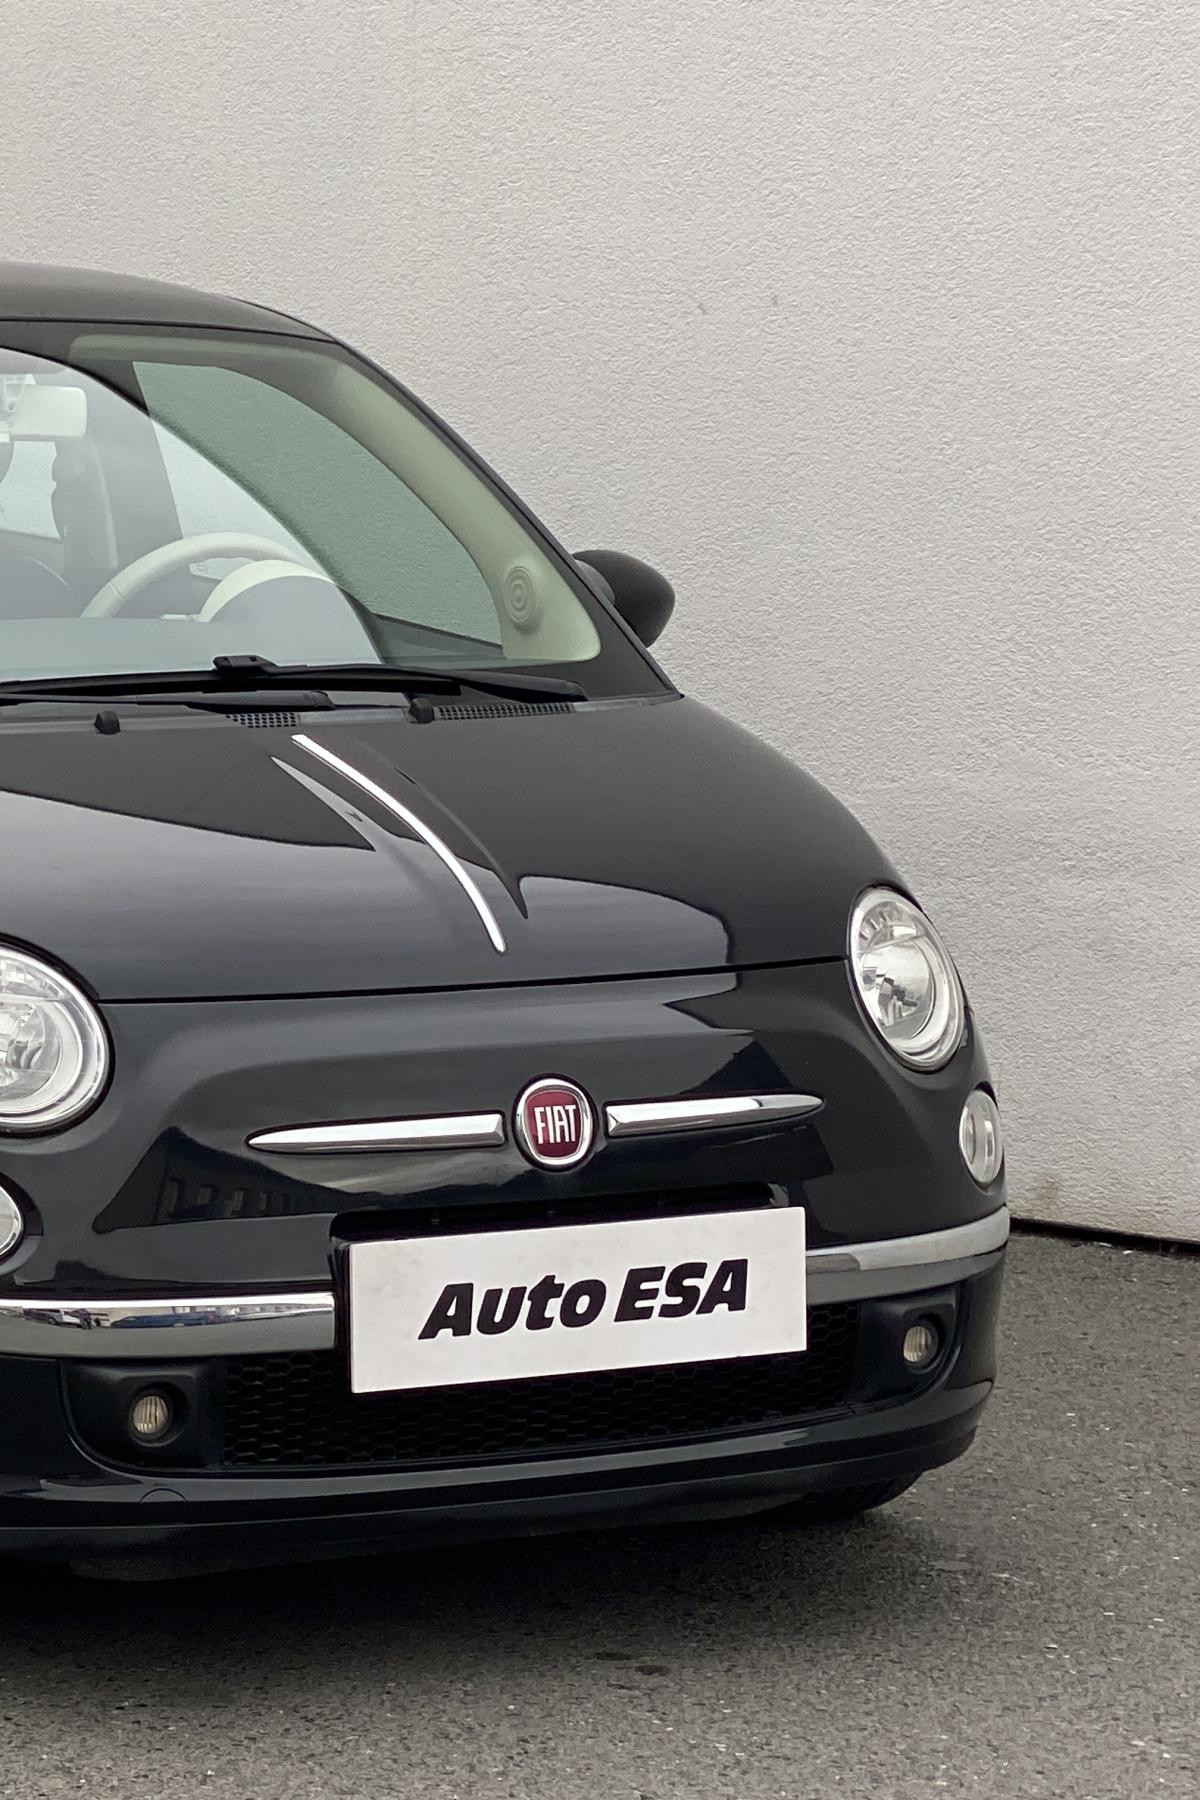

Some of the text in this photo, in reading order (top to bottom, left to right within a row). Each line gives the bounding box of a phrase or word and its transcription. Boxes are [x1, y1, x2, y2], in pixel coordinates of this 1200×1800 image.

[534, 1105, 576, 1144] FIAT
[418, 1258, 749, 1340] Auto ESA
